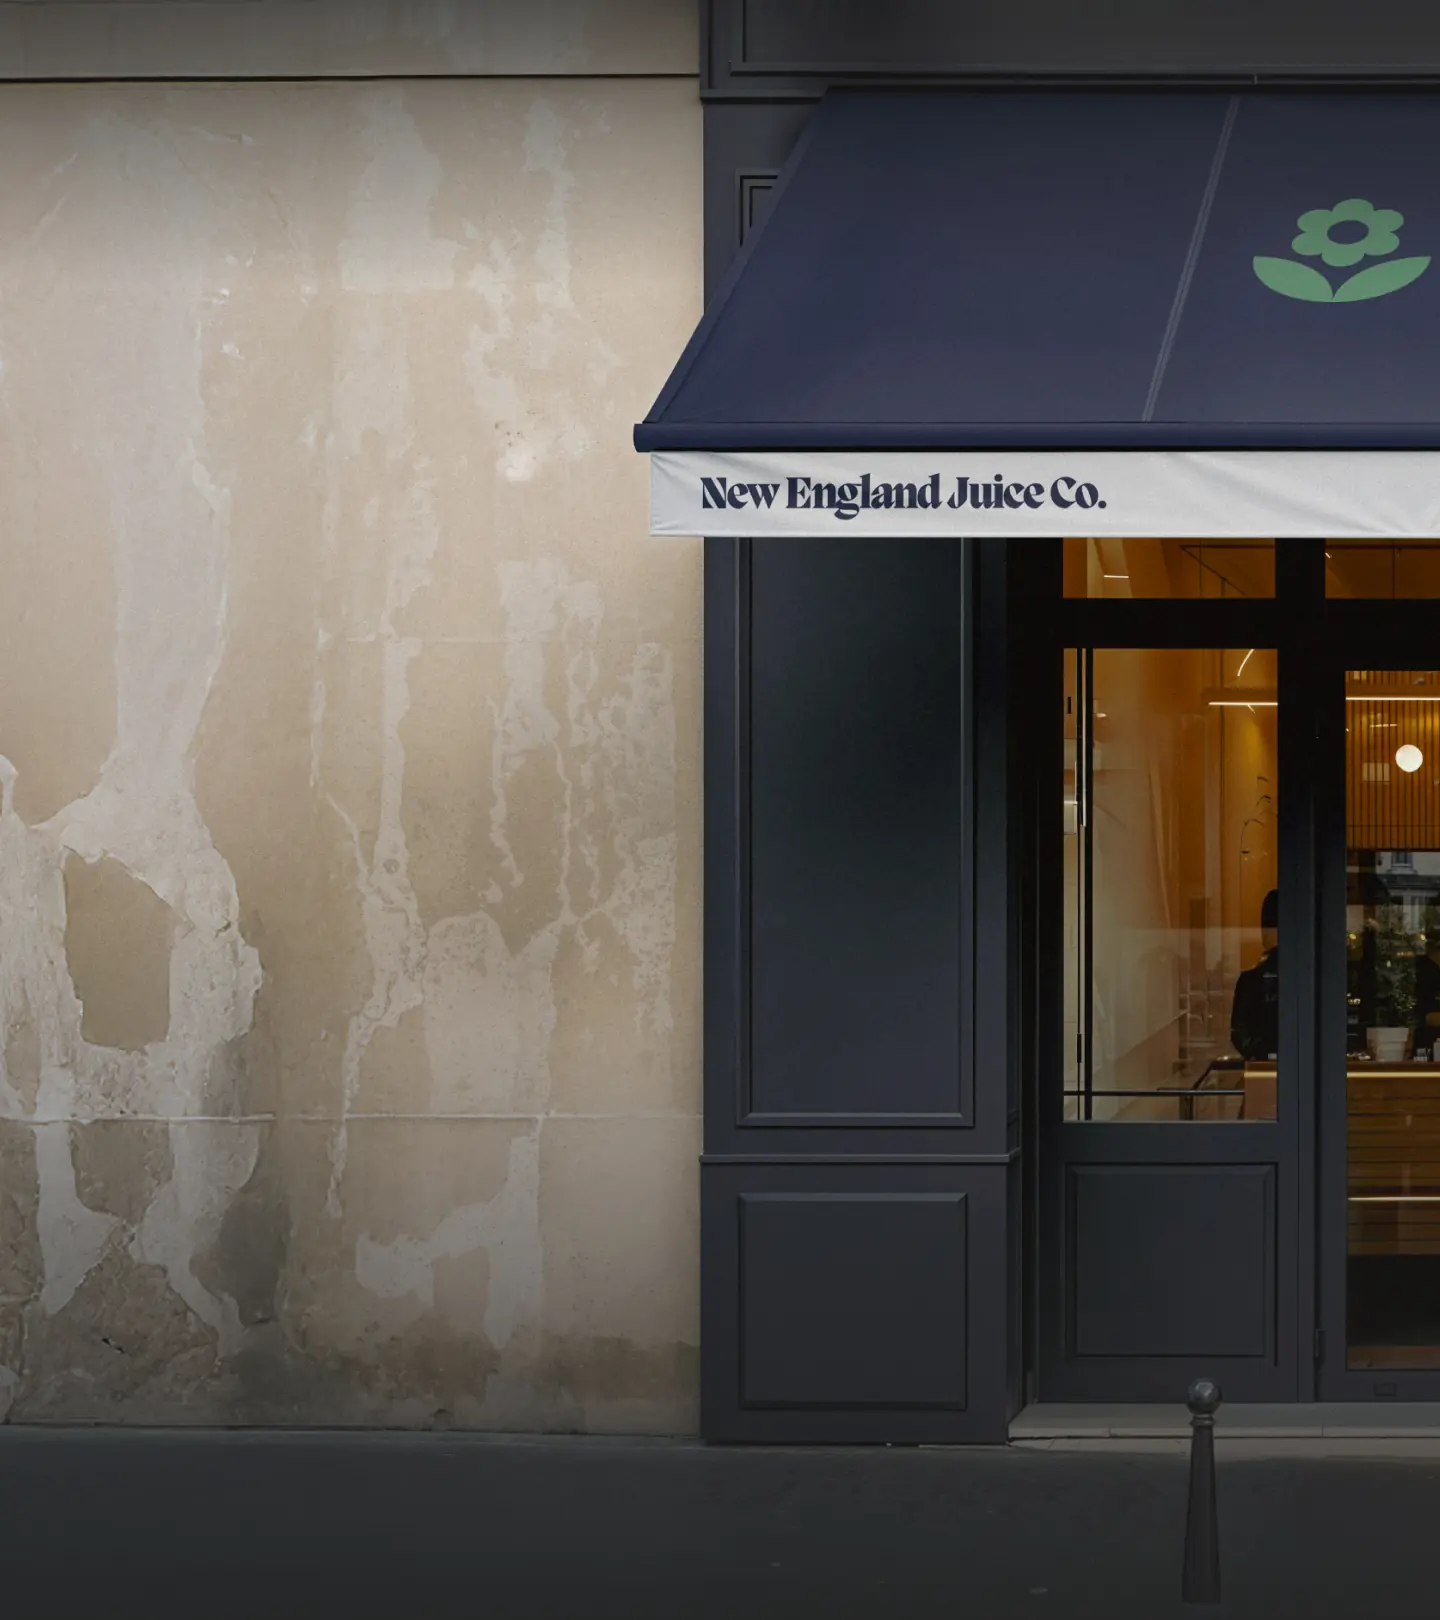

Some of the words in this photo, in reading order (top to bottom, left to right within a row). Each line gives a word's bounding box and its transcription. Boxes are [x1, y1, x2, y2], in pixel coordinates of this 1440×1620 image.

[699, 476, 780, 510] New
[785, 472, 942, 521] England
[946, 473, 1045, 510] Juice
[1050, 476, 1107, 510] Co.
